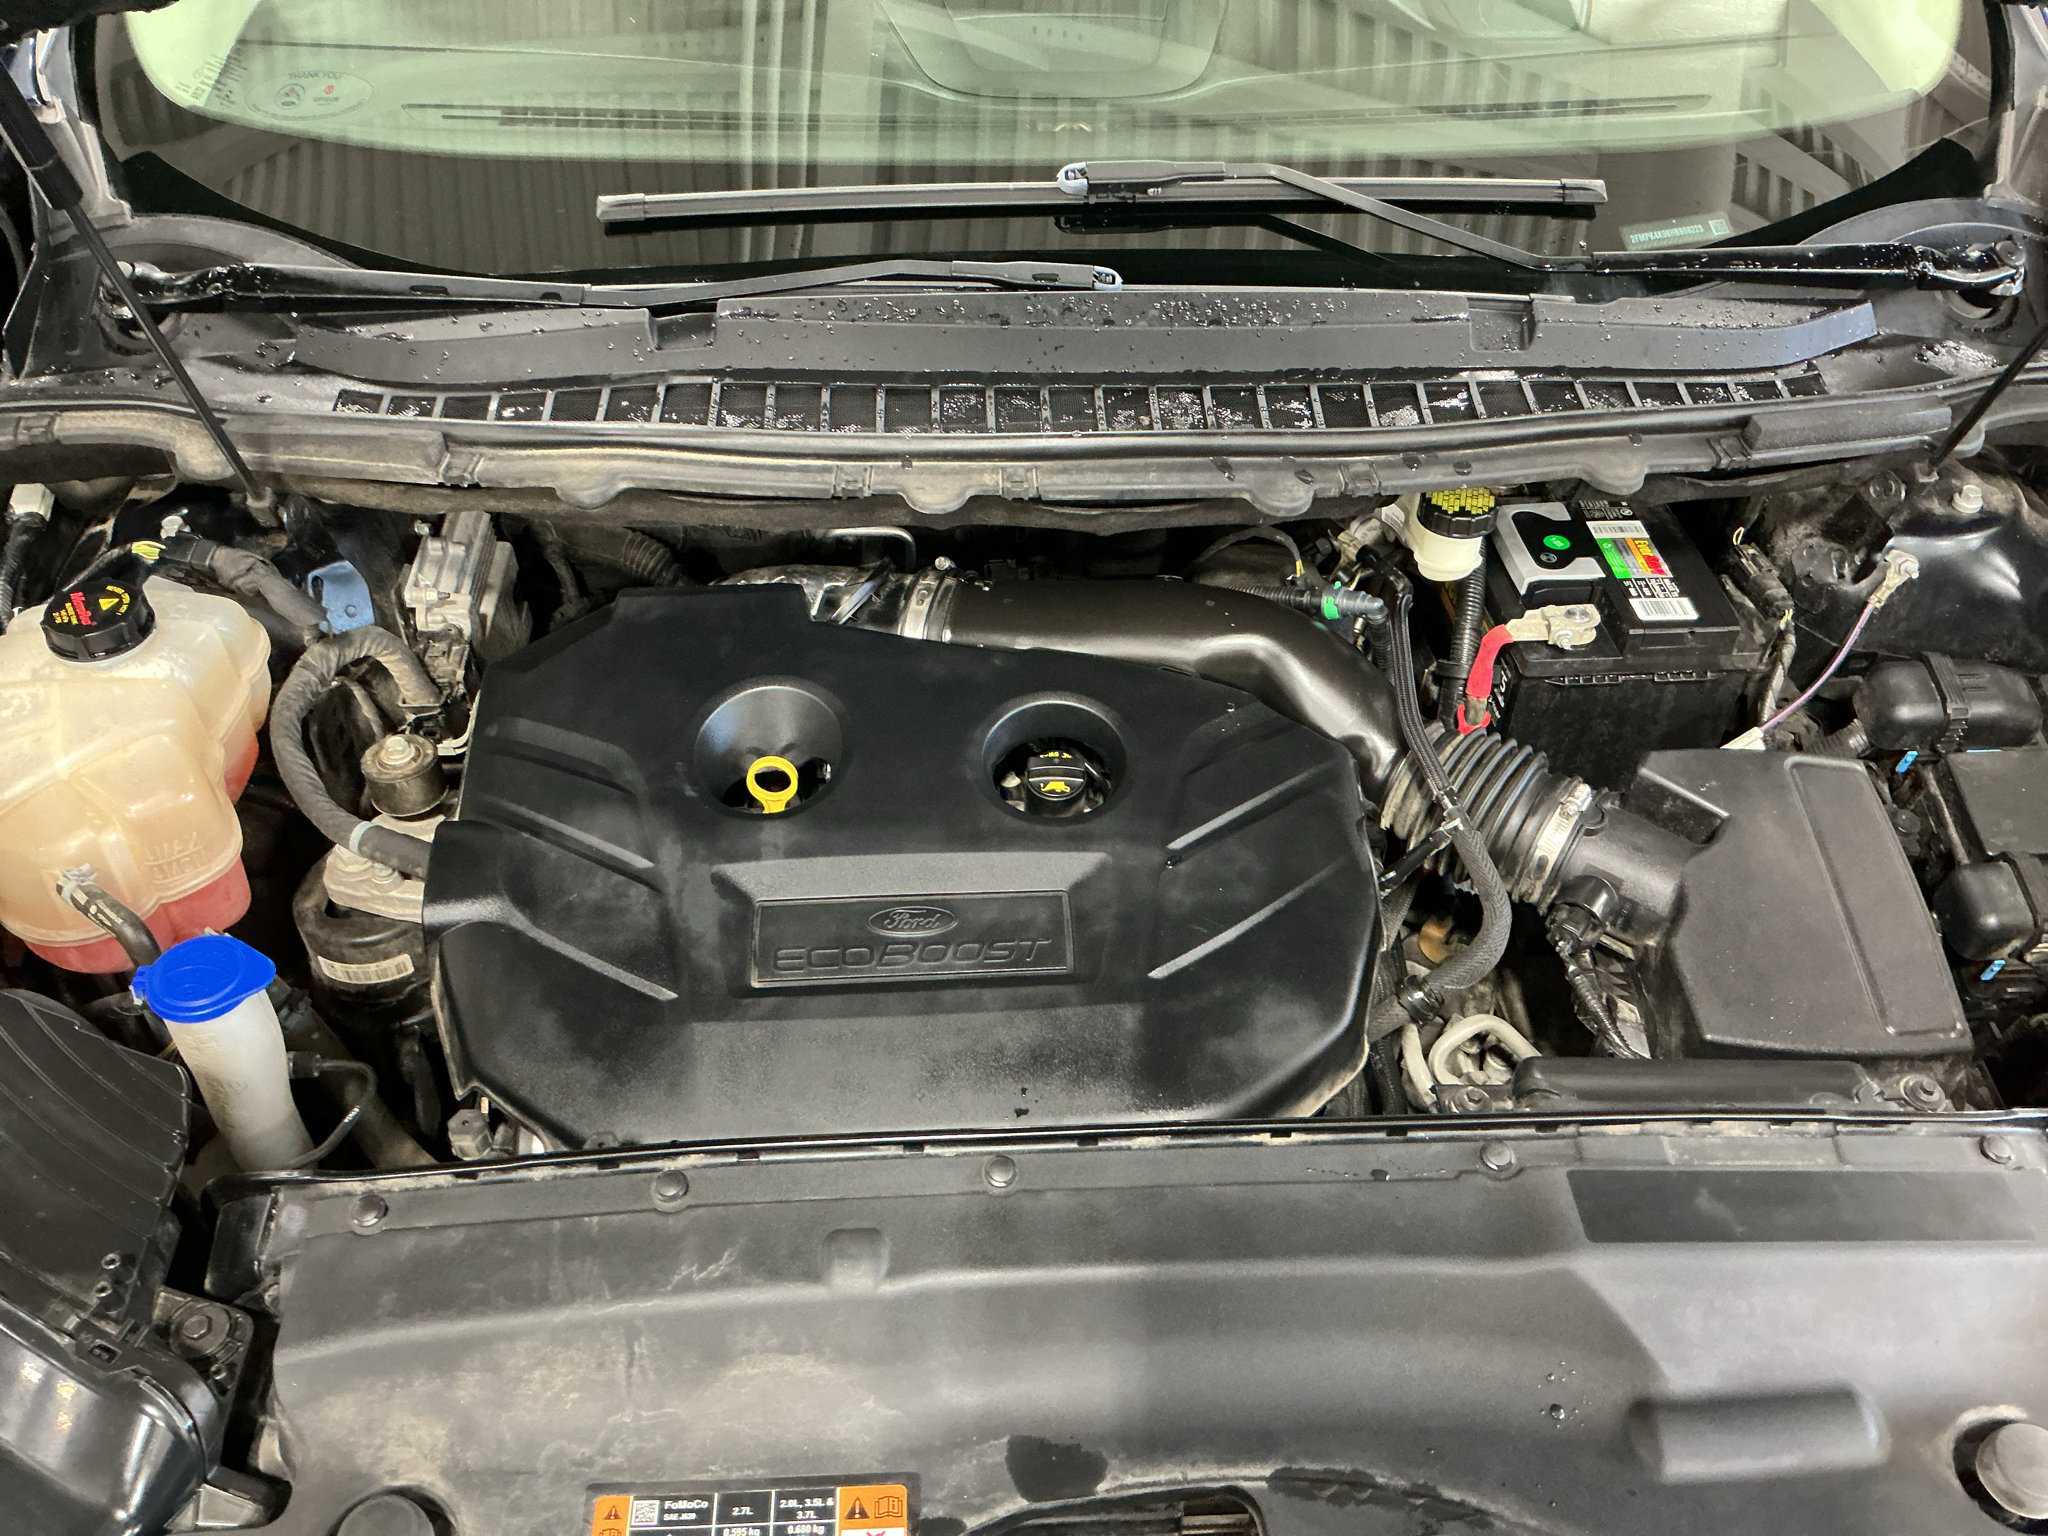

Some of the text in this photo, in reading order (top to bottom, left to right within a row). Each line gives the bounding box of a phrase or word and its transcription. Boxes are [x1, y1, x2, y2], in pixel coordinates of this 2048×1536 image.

[288, 70, 341, 80] THANK YOU
[883, 909, 941, 930] Ford
[772, 938, 1051, 973] ECOBOOST
[664, 1500, 709, 1510] FoMoCo
[804, 1498, 825, 1507] 3.5L
[732, 1506, 754, 1516] 2.7L
[796, 1510, 818, 1520] 3.7L
[748, 1527, 761, 1536] kg
[812, 1524, 825, 1534] kg
